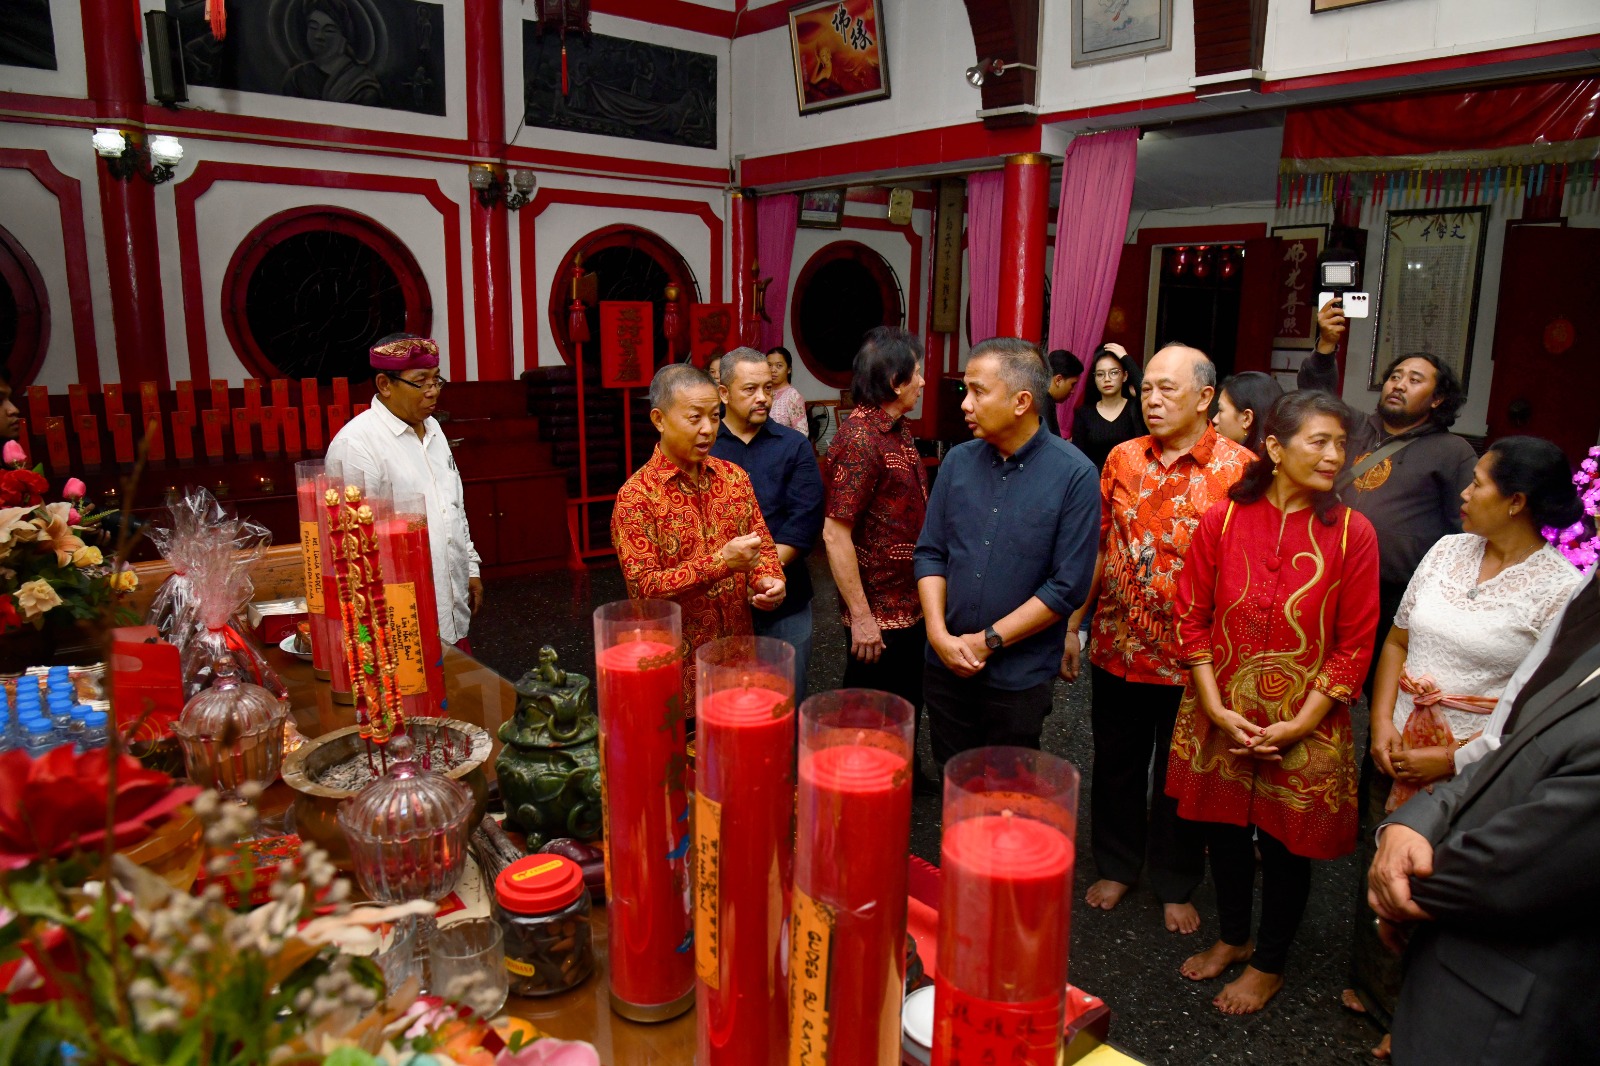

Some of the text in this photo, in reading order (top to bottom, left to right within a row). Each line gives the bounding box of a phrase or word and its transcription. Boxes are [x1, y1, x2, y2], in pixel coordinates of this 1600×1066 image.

[1281, 241, 1308, 335] 佛光普照
[799, 930, 822, 1066] GUDEG BU RATN
